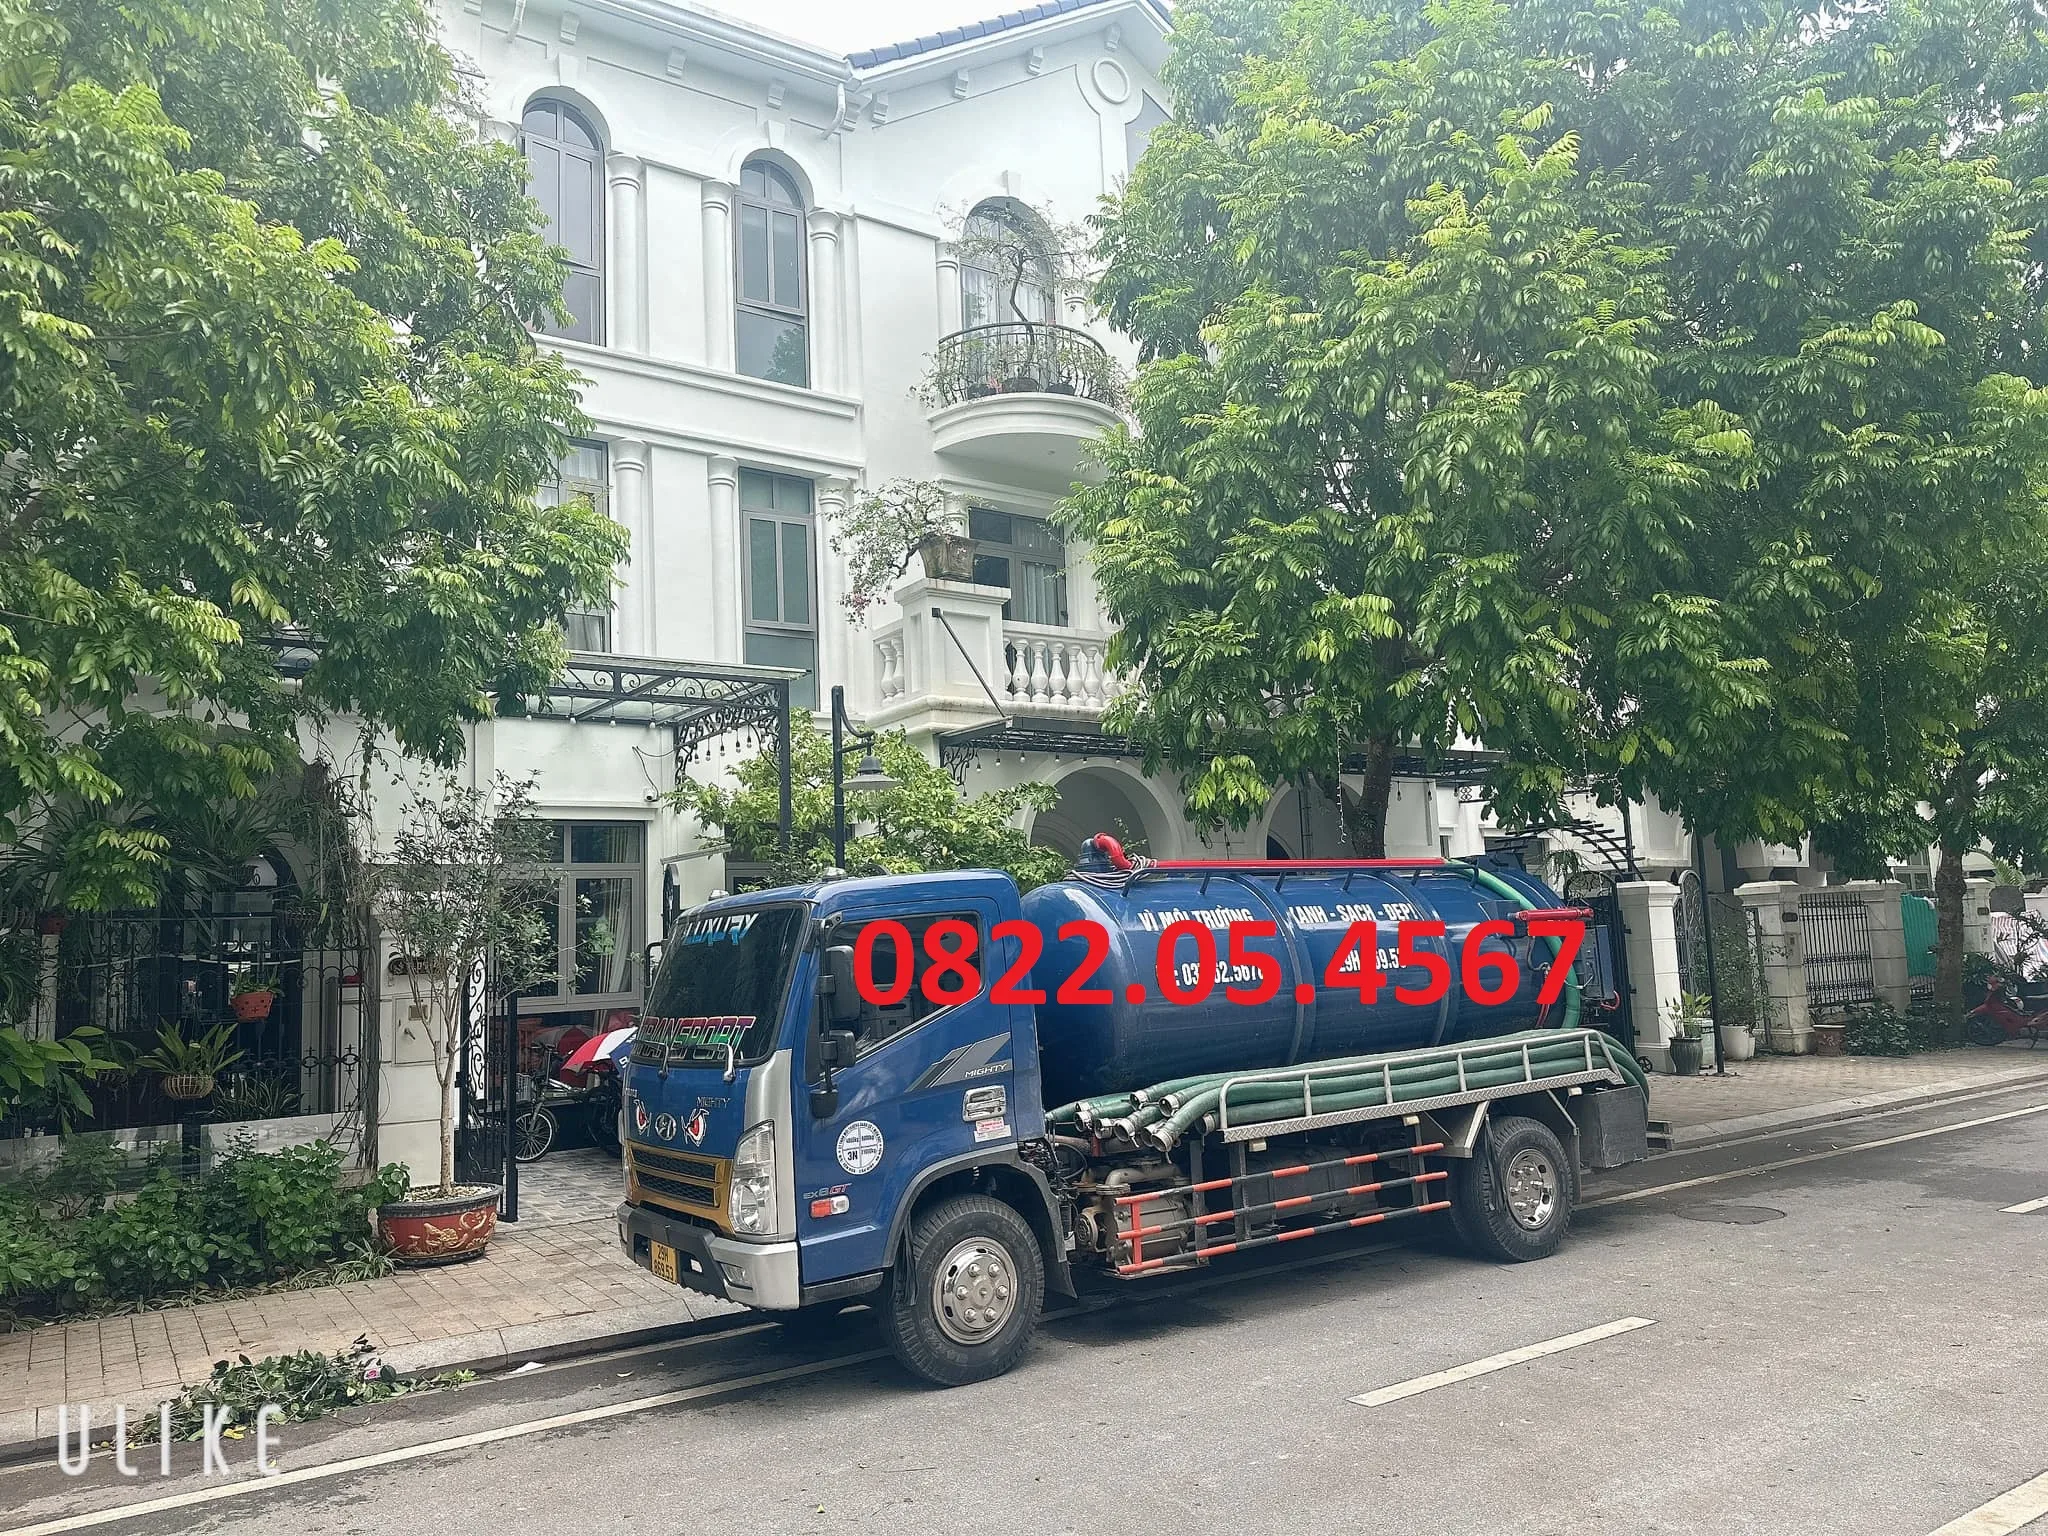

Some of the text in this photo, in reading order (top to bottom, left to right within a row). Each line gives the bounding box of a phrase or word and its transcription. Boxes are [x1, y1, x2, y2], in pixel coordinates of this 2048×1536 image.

[965, 1063, 1007, 1078] MIGHTY
[847, 1150, 858, 1161] 3N
[657, 1244, 669, 1263] 29H
